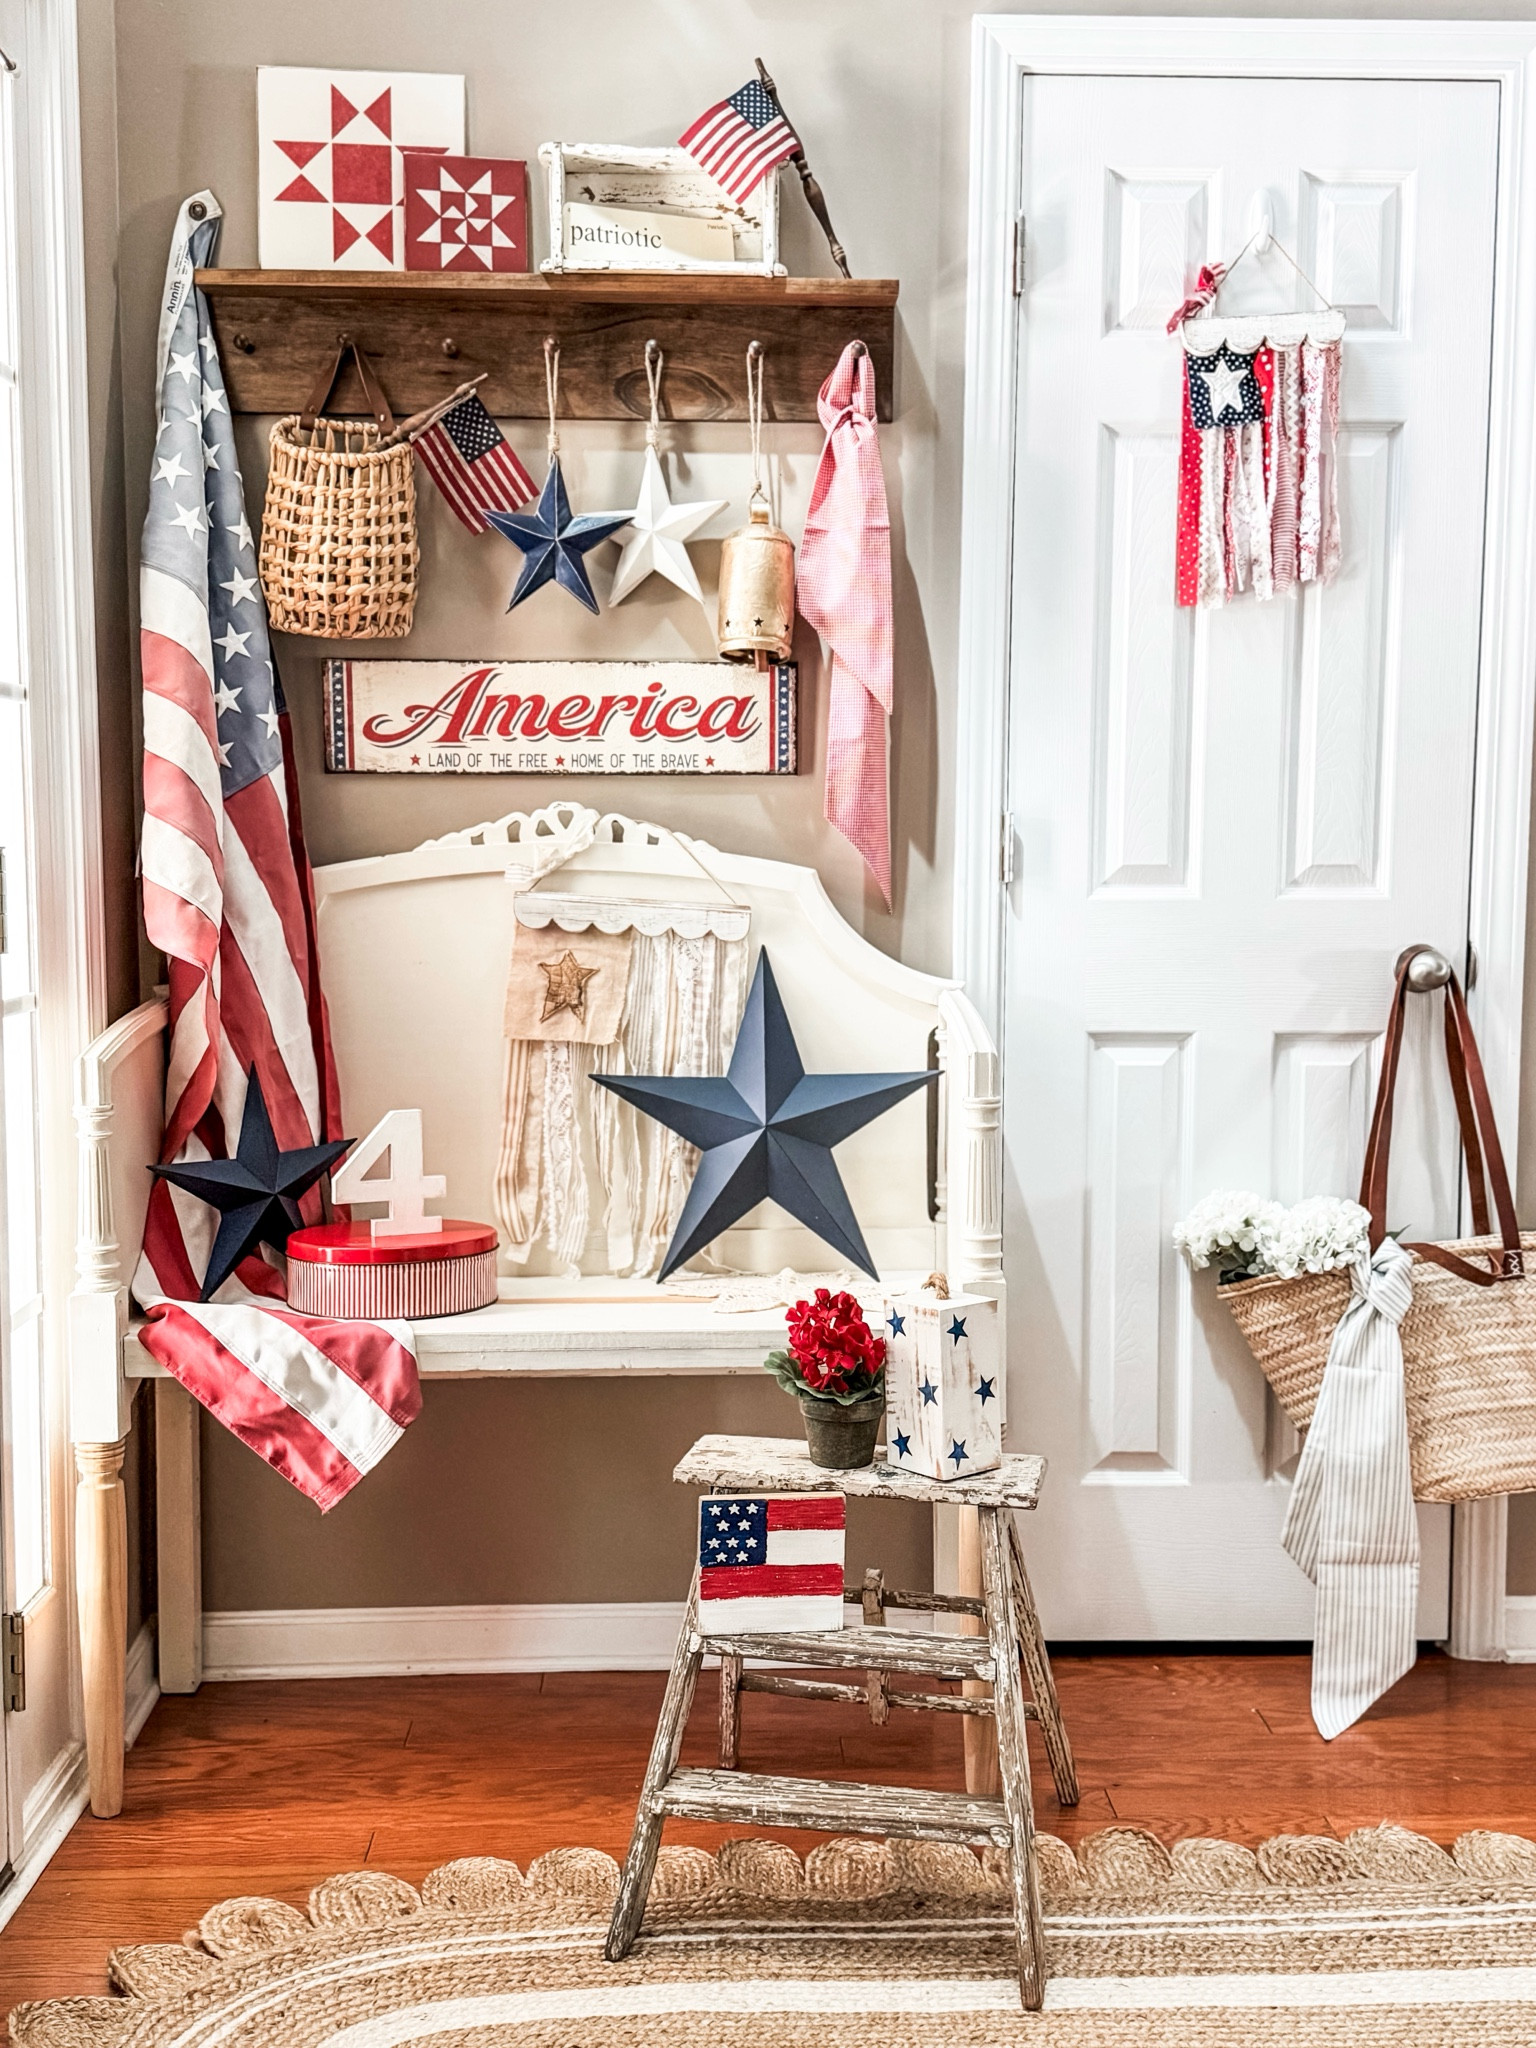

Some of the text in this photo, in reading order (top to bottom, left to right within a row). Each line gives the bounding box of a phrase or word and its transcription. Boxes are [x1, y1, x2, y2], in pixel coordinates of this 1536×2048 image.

[570, 224, 662, 249] patriotic
[167, 279, 182, 314] Annin
[362, 667, 761, 746] America
[428, 752, 700, 769] LAND OF THE FREE HOME OF THE BRAVE
[331, 1107, 447, 1238] 4
